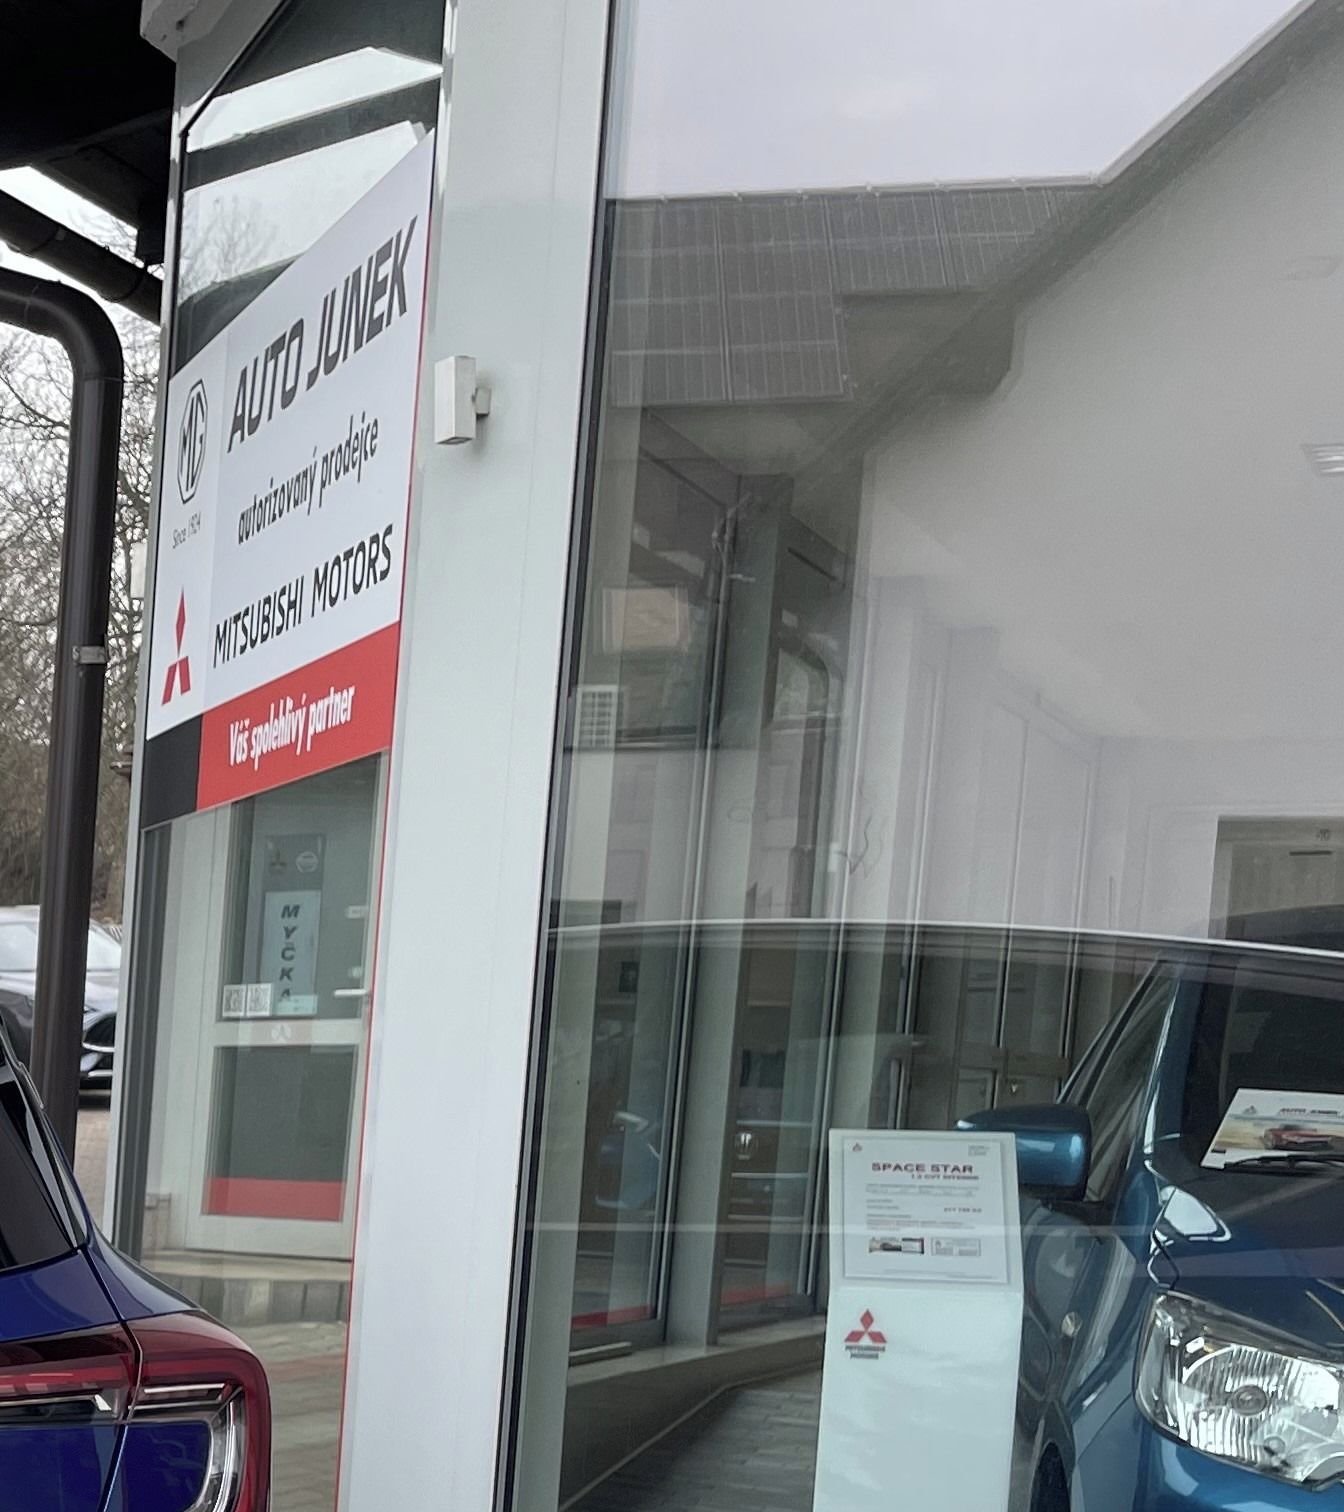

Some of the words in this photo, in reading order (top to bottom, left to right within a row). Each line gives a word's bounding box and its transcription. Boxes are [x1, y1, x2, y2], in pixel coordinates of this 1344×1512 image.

[227, 318, 304, 454] AUTO
[306, 215, 418, 392] JUNEK
[238, 446, 318, 544] autorizovaný
[319, 411, 379, 508] prodejce
[172, 528, 186, 549] Since
[213, 575, 304, 668] MITSUBISHI
[311, 523, 393, 618] MOTORS
[229, 718, 250, 767] Váš
[251, 692, 307, 771] spolehlivý
[307, 685, 356, 752] partner
[871, 1162, 926, 1172] SPACE
[930, 1163, 974, 1174] STAR
